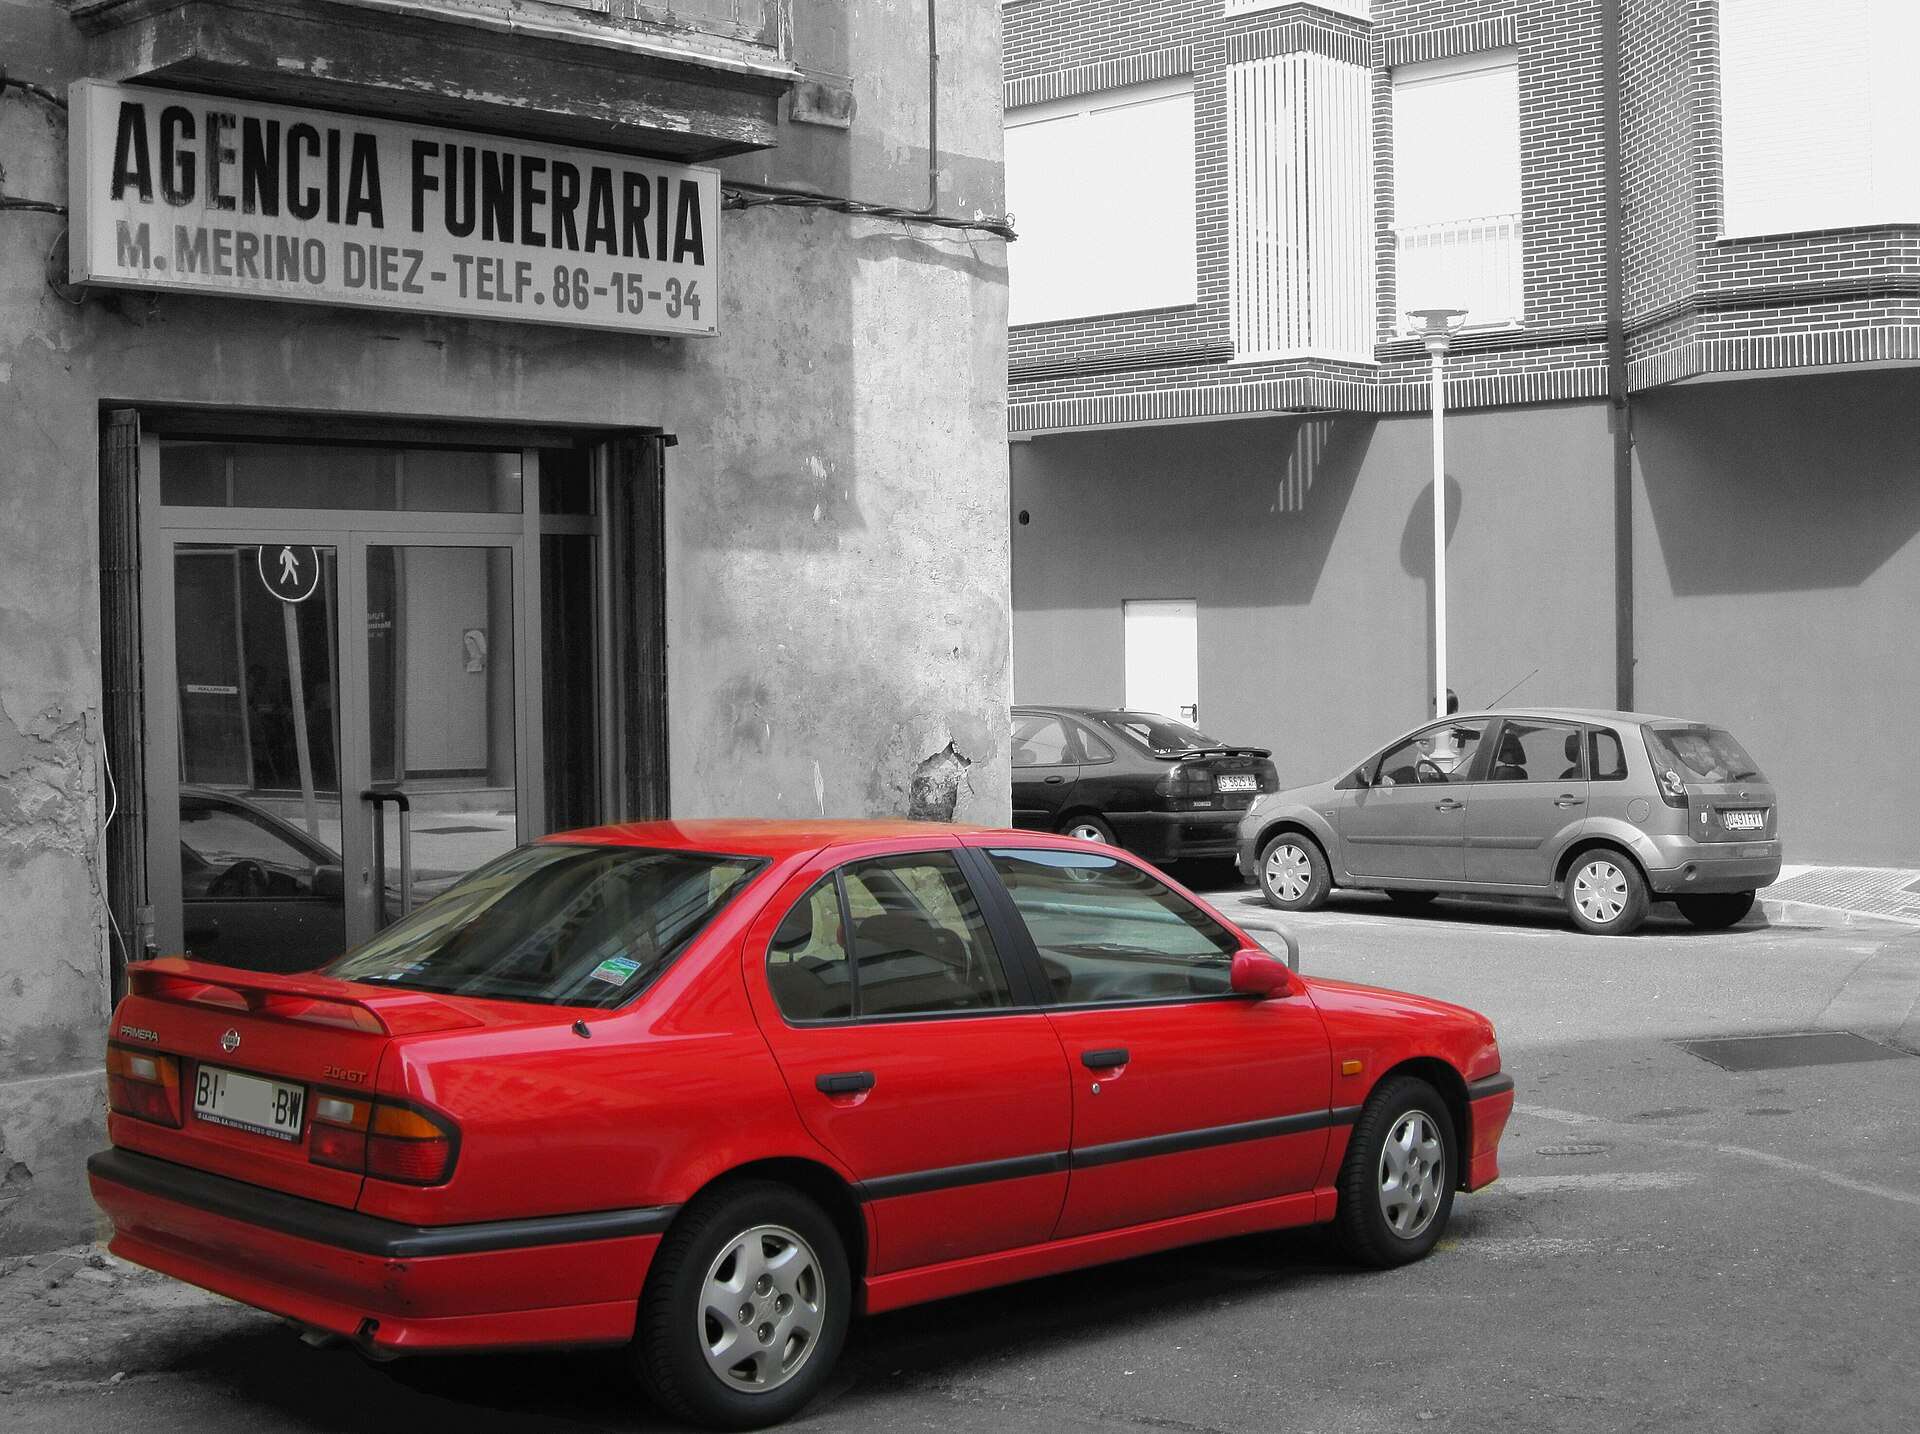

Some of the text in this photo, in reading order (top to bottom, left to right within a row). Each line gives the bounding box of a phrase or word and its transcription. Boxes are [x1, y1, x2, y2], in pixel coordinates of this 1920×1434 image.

[110, 101, 705, 266] AGENCIA FUNERARIA
[115, 219, 168, 271] M.
[174, 224, 327, 285] MERINO
[120, 1025, 159, 1041] PRIMERA
